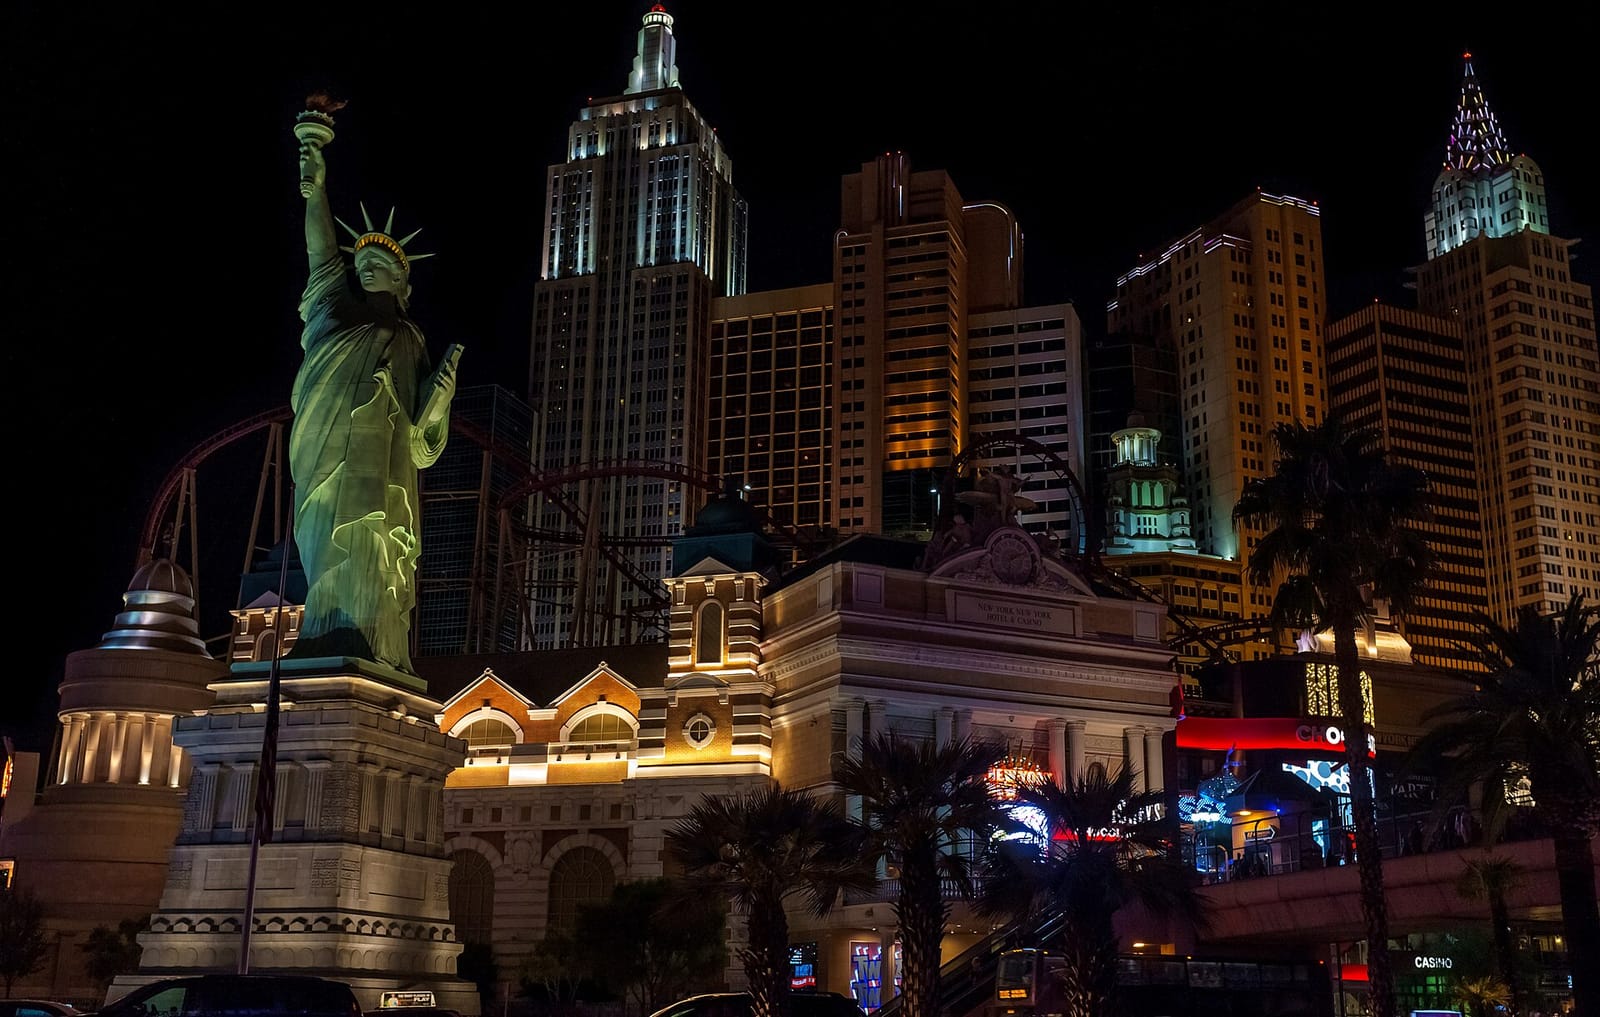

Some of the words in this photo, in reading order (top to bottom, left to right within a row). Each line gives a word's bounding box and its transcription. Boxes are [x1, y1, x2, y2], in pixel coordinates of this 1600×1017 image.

[978, 602, 993, 612] NEW
[996, 606, 1015, 615] YORK
[1033, 609, 1051, 619] YORK
[986, 613, 1007, 623] HOTEL
[1017, 617, 1042, 626] CASINO
[1414, 956, 1453, 969] CASINO
